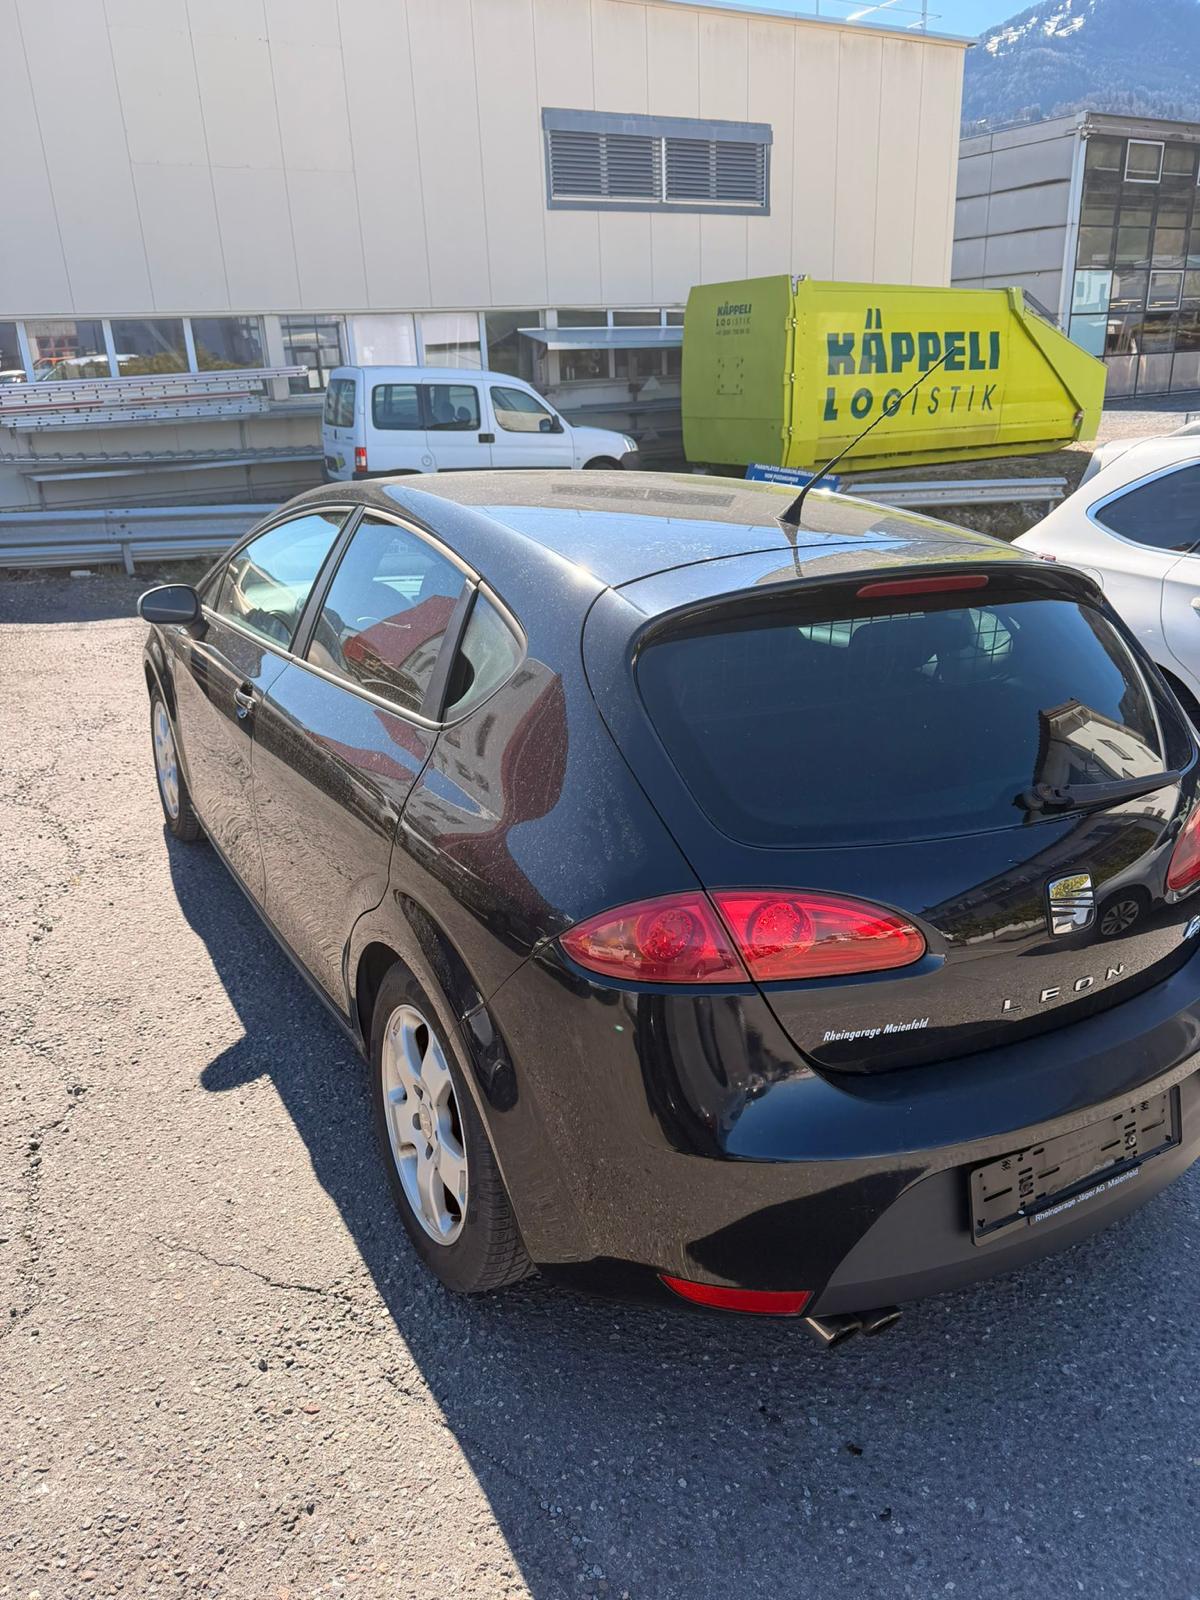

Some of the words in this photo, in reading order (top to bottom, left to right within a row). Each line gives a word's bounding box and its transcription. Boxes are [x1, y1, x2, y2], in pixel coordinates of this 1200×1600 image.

[716, 301, 752, 317] KÄPPELI
[827, 308, 1000, 376] KÄPPELI
[823, 384, 997, 421] LOGISTIK
[1001, 962, 1126, 1014] LEON
[823, 1029, 882, 1042] Rheingarage
[883, 1017, 929, 1034] Maienfeld
[1035, 1199, 1077, 1222] Rheingarage
[1095, 1184, 1106, 1194] AG
[1107, 1168, 1139, 1188] Maienfeld
